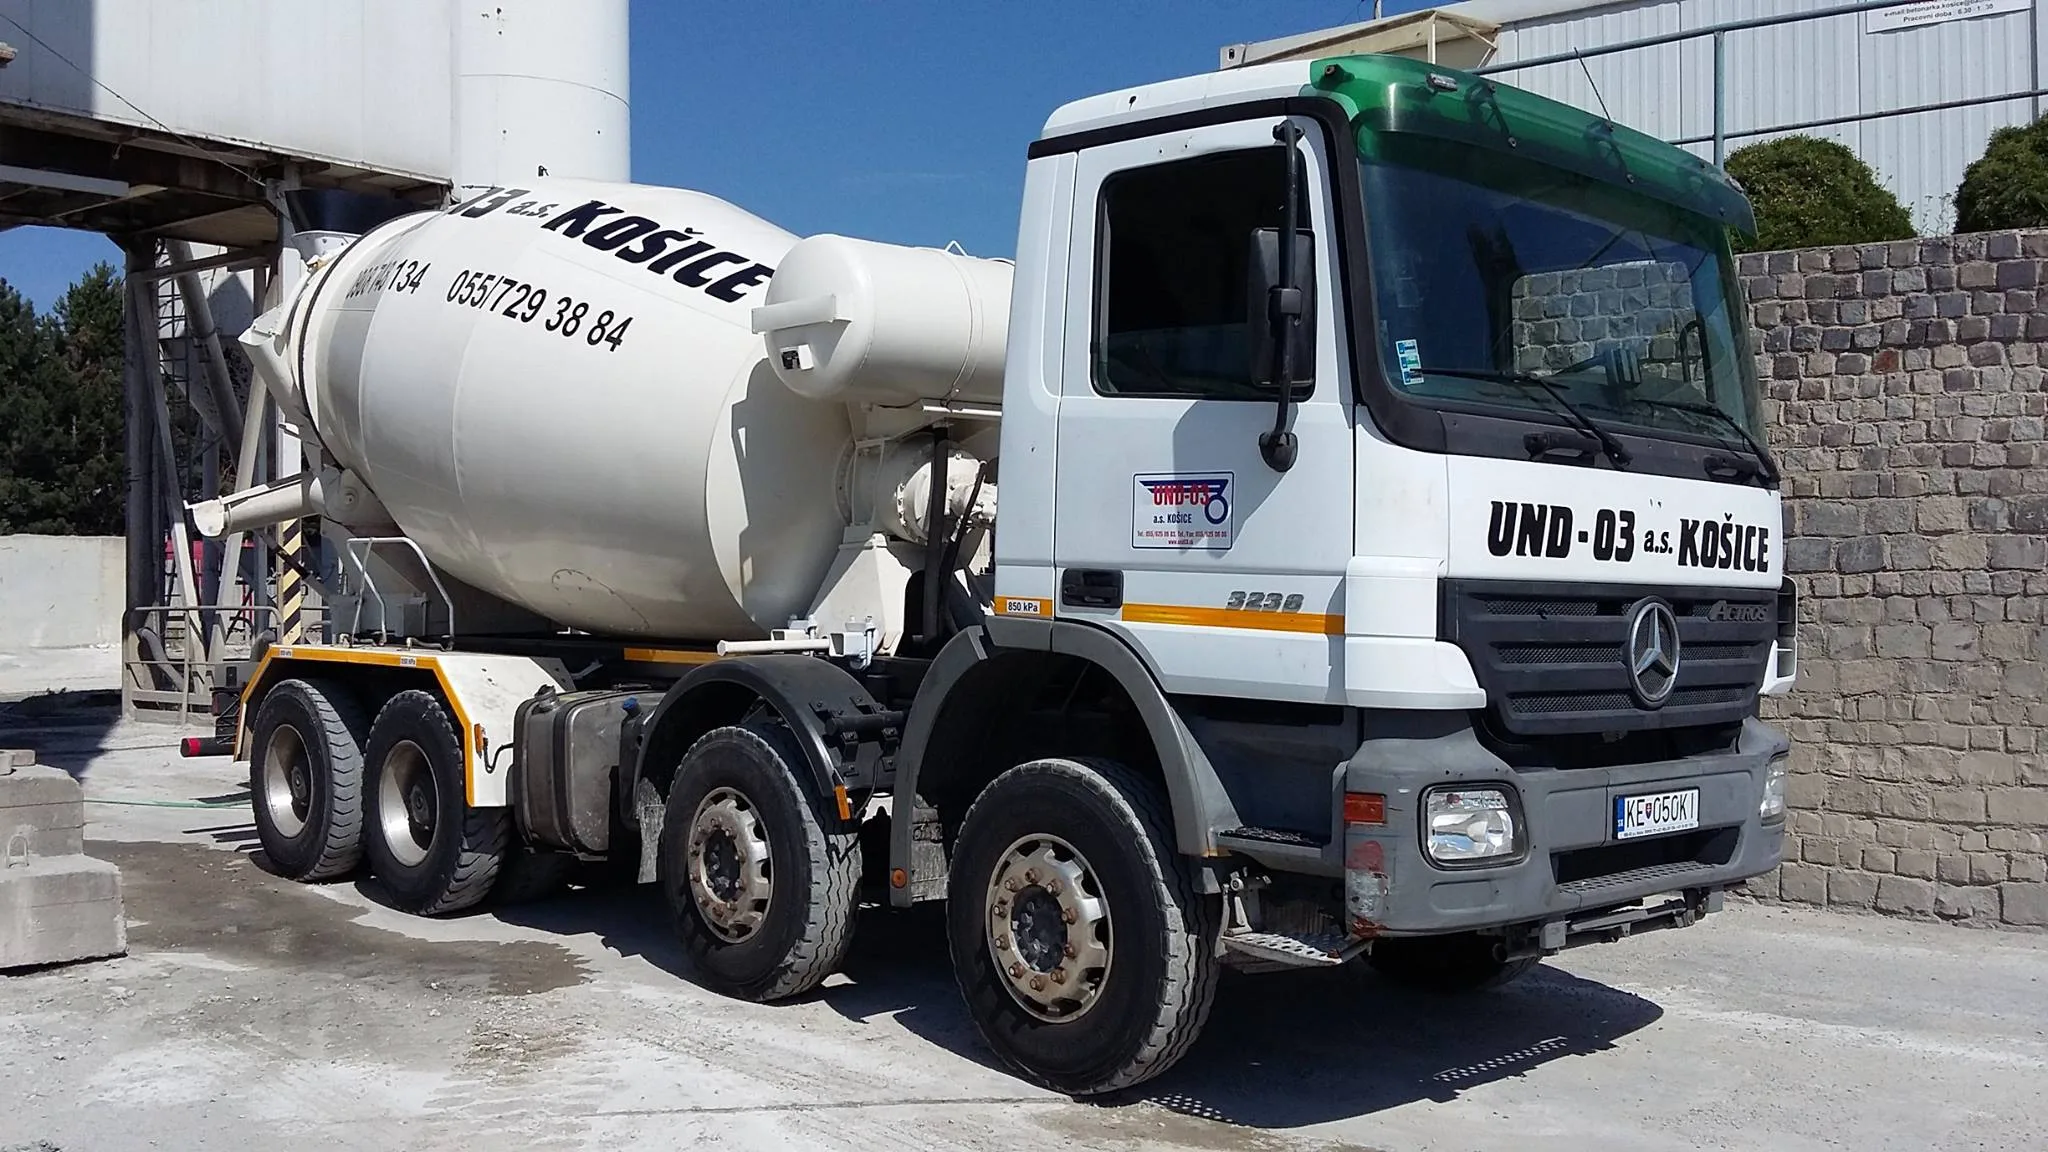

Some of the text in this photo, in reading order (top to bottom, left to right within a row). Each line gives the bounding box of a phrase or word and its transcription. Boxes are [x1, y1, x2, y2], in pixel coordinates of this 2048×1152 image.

[540, 200, 775, 302] KOŠICE
[446, 269, 634, 352] 055/729 38 84
[1153, 483, 1209, 505] UND-03
[1153, 511, 1192, 524] a.s. KOŠICE
[1644, 529, 1673, 555] a.s.
[1677, 511, 1769, 572] KOŠICE
[1008, 601, 1038, 612] 850 kPa
